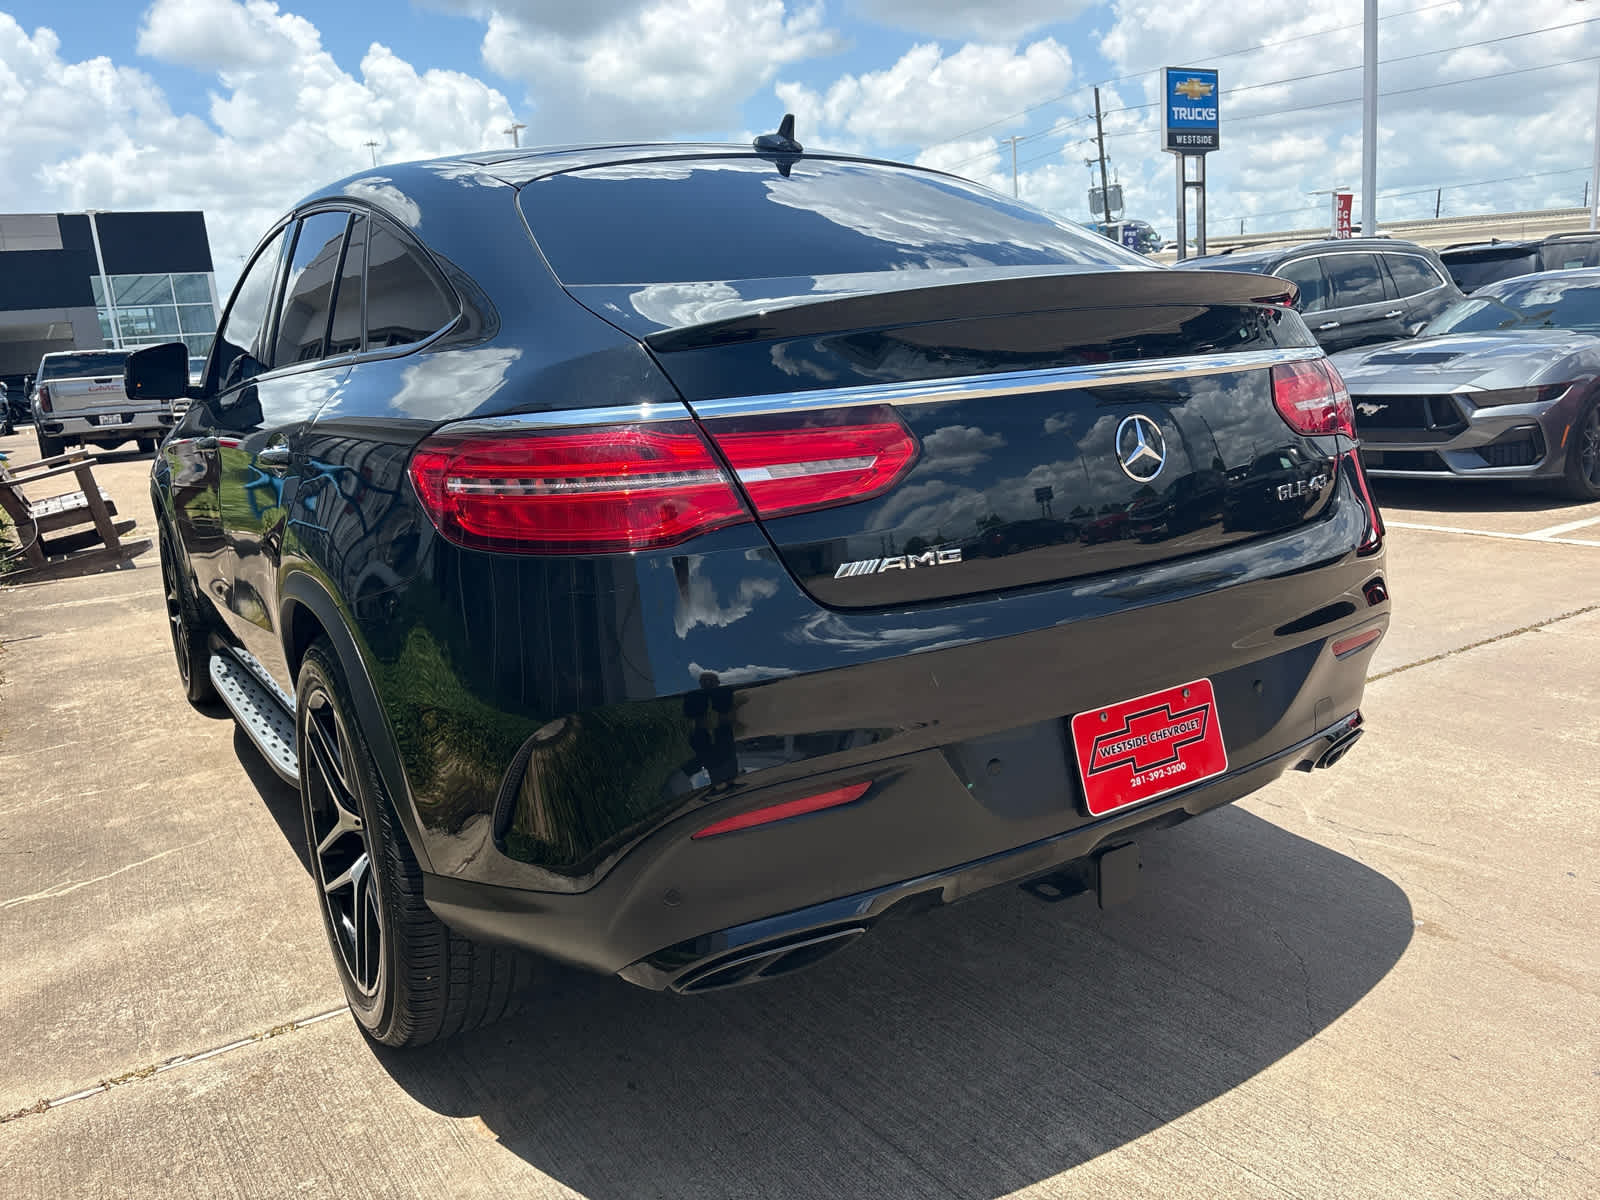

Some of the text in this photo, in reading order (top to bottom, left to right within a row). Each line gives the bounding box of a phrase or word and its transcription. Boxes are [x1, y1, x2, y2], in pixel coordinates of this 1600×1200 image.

[1172, 107, 1216, 120] TRUCKS
[1176, 135, 1213, 144] WESTSIDE
[1277, 480, 1307, 501] GLE
[877, 548, 962, 574] AMG
[1099, 718, 1201, 758] WESTSIDE CHEVROLET
[1130, 761, 1187, 788] 281-392-3200
